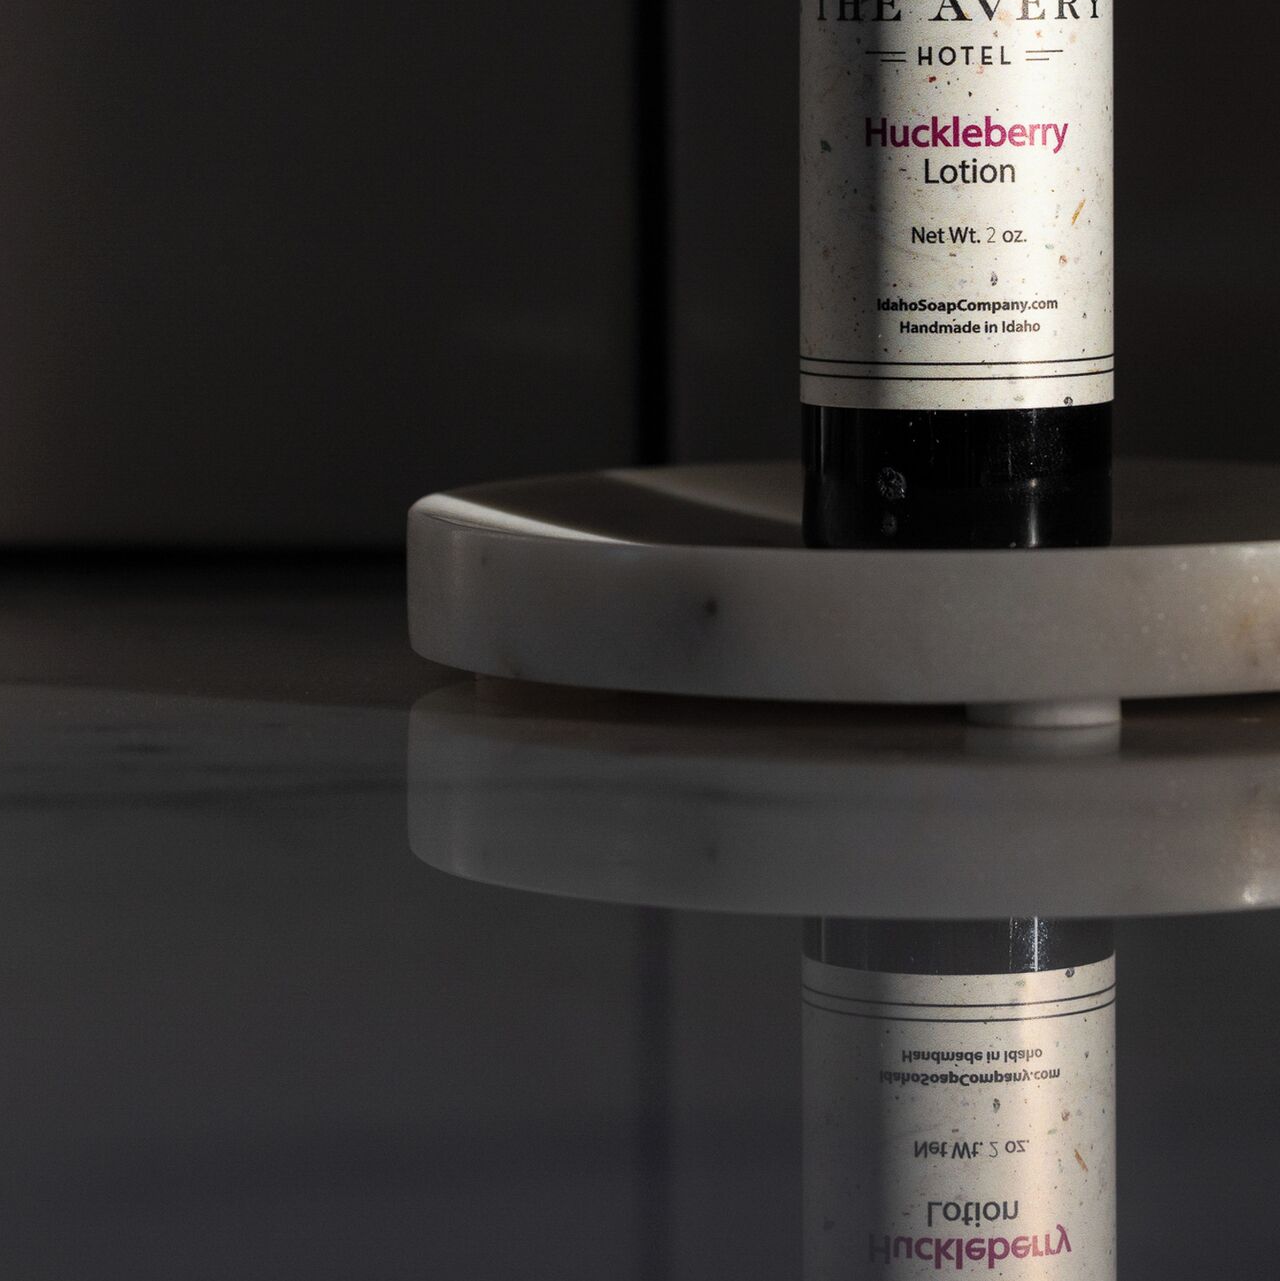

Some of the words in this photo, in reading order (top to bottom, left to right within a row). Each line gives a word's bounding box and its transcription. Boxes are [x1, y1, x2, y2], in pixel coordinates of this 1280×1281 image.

[917, 45, 1012, 66] HOTEL
[865, 115, 1069, 154] Huckleberry
[923, 158, 1017, 184] Lotion
[911, 226, 945, 244] Net
[948, 226, 981, 244] Wt.
[986, 226, 997, 244] 2
[1002, 229, 1028, 244] oz.
[876, 298, 1059, 314] IdahoSoapCompany.com
[899, 320, 981, 335] Handmade
[984, 321, 998, 334] in
[1002, 320, 1041, 334] Idaho
